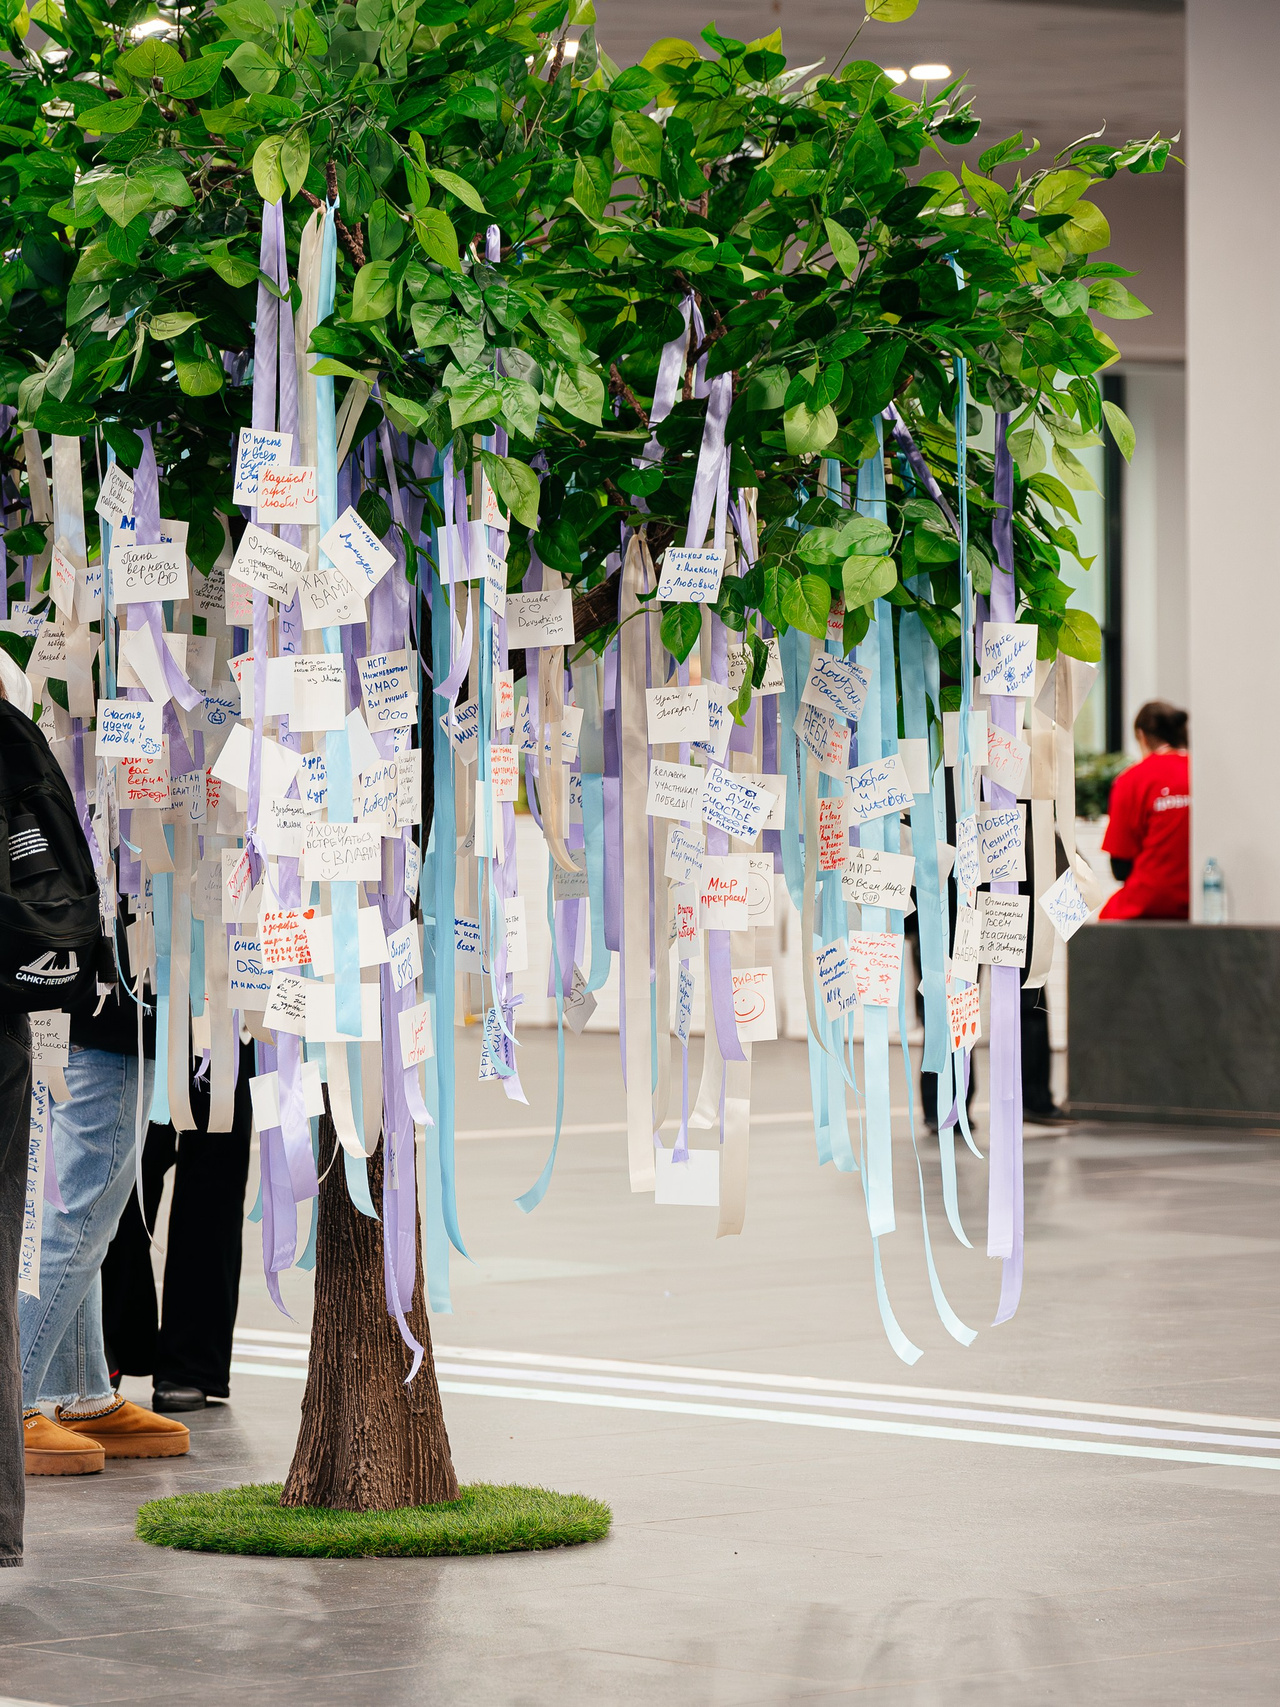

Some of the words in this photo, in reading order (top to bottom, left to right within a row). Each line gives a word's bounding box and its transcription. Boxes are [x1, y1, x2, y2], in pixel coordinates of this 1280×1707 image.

[144, 571, 178, 587] СВО
[364, 678, 399, 696] ХМАО
[708, 700, 723, 717] ИРА
[804, 712, 829, 749] НЕБА
[364, 763, 397, 788] ХМАО
[977, 810, 1021, 835] ПОБЕДЫ
[321, 852, 331, 863] С
[707, 877, 738, 894] Мир
[15, 972, 78, 986] САНКТ-ПЕТЕРБУРГ
